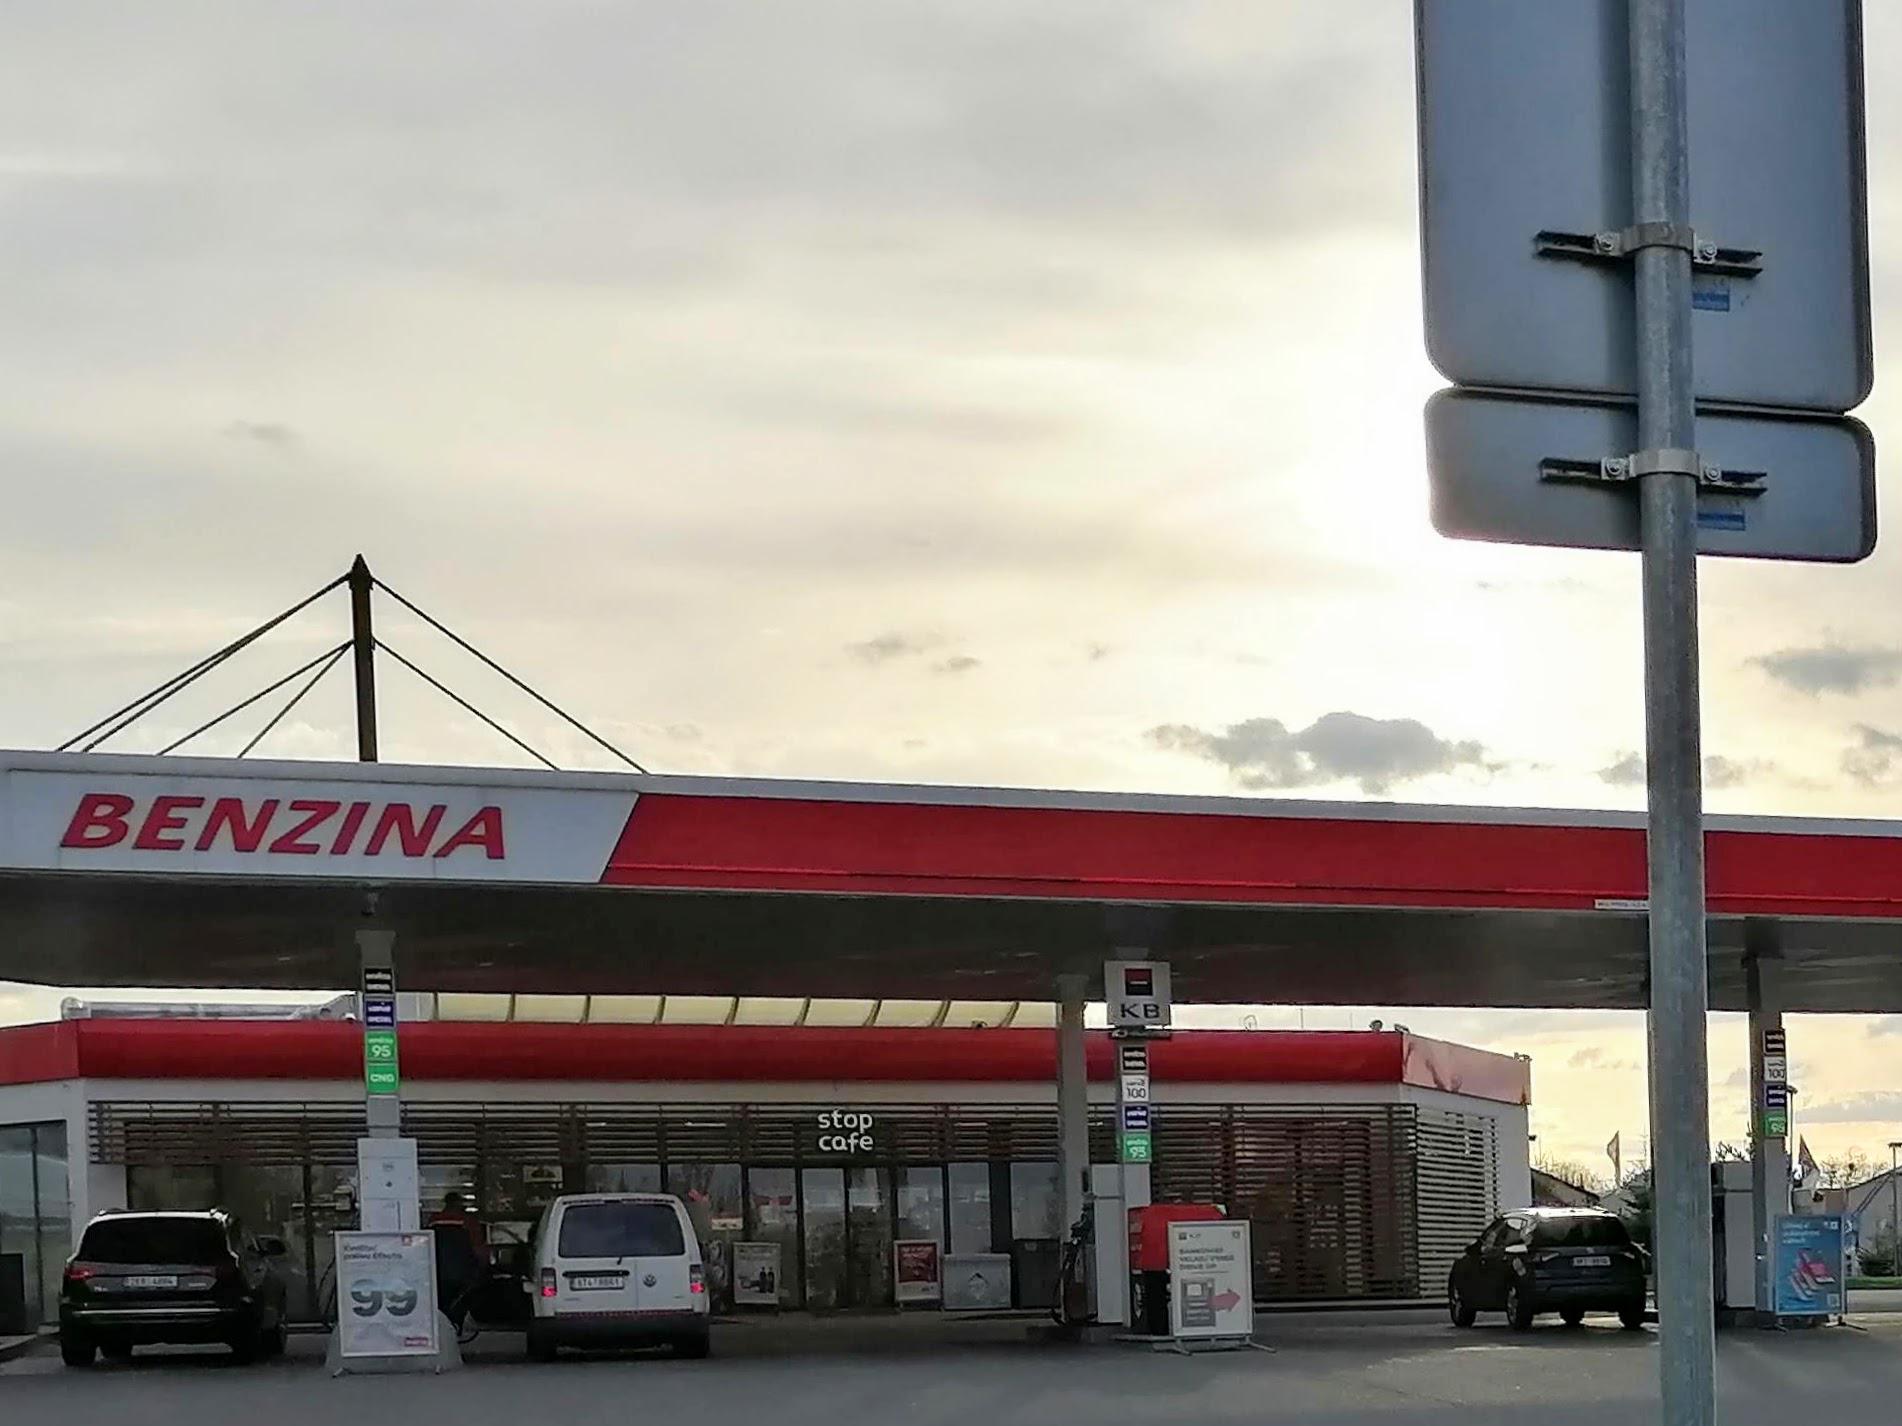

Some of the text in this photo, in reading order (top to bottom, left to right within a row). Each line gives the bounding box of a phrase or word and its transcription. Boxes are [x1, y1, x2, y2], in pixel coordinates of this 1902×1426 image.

[60, 793, 505, 859] BENZINA
[1121, 1003, 1159, 1018] KB
[371, 1044, 392, 1058] 95
[1126, 1087, 1146, 1099] 100
[818, 1110, 873, 1133] stop
[819, 1132, 873, 1154] cafe
[1130, 1146, 1147, 1158] 95
[351, 1278, 418, 1317] 99
